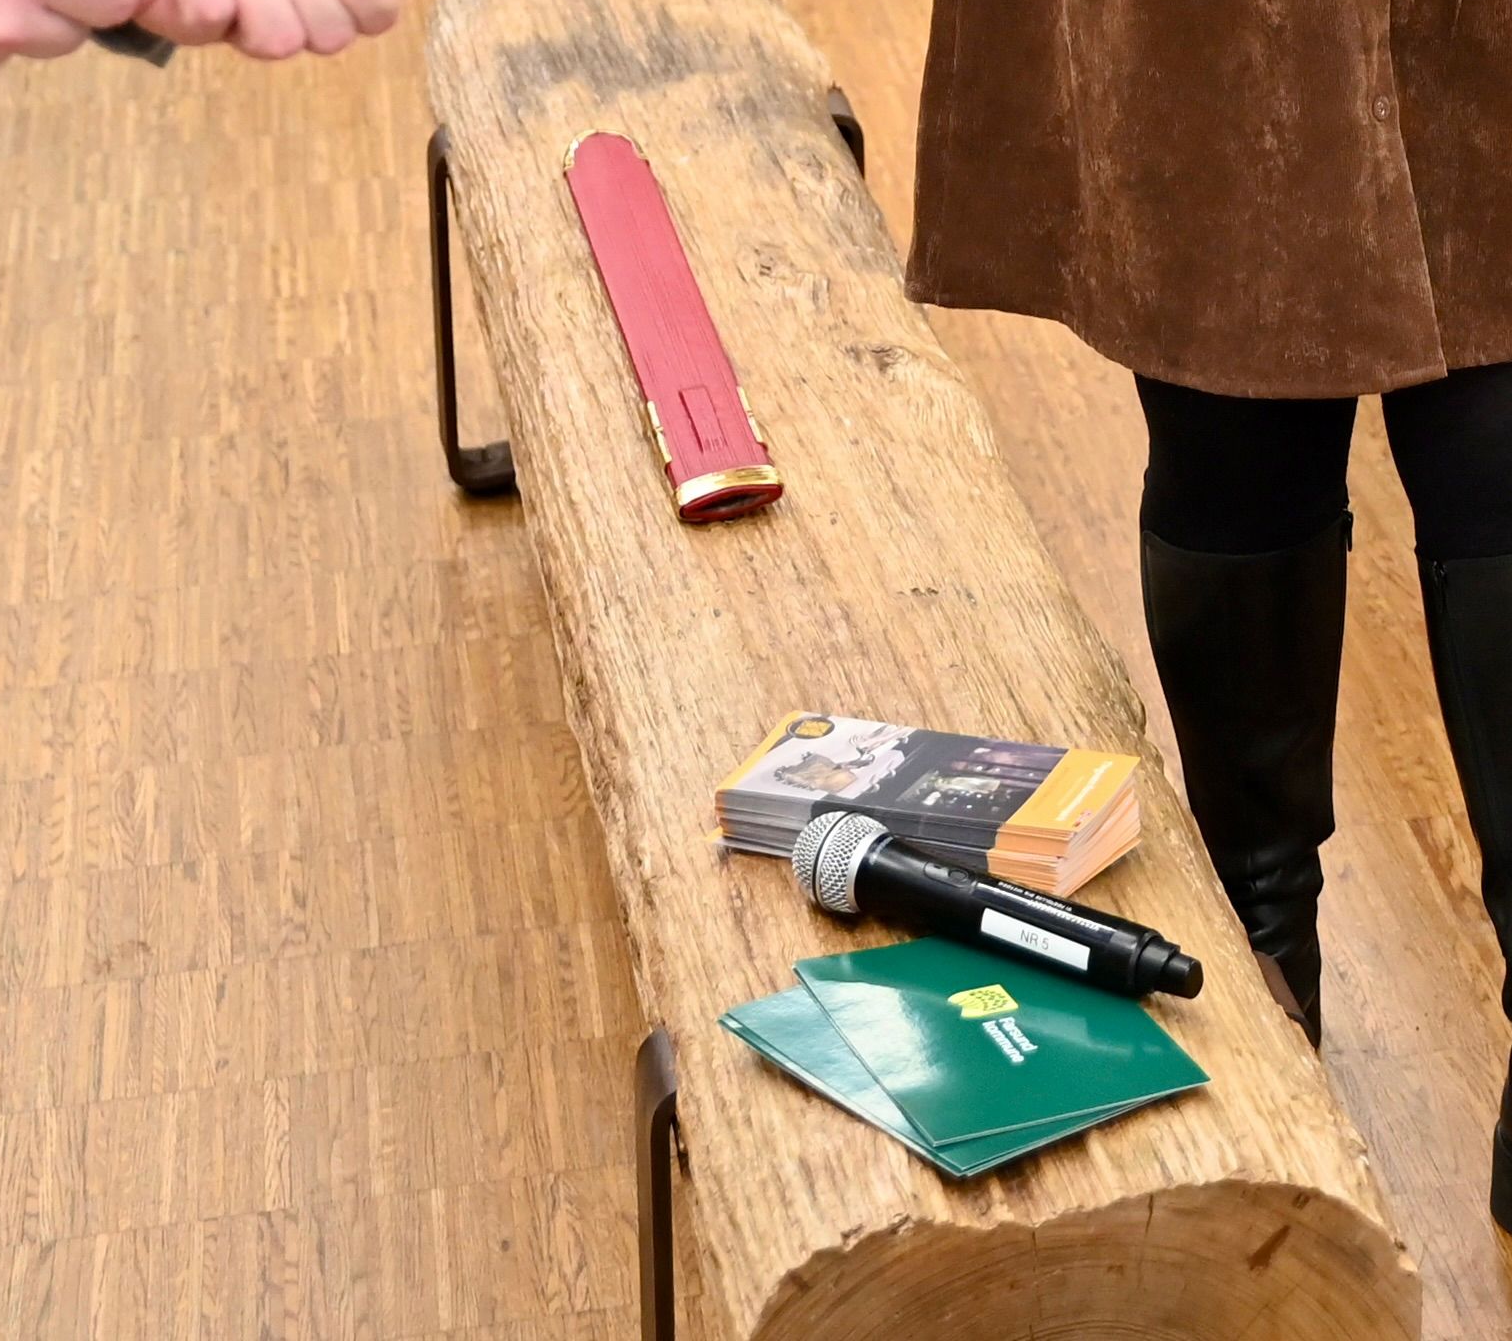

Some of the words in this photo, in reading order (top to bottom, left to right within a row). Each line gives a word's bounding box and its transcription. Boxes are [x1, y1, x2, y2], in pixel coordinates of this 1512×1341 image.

[1020, 928, 1039, 946] NR
[1041, 937, 1050, 951] 5
[982, 1020, 1024, 1063] kommune
[999, 1017, 1038, 1051] Farsund
